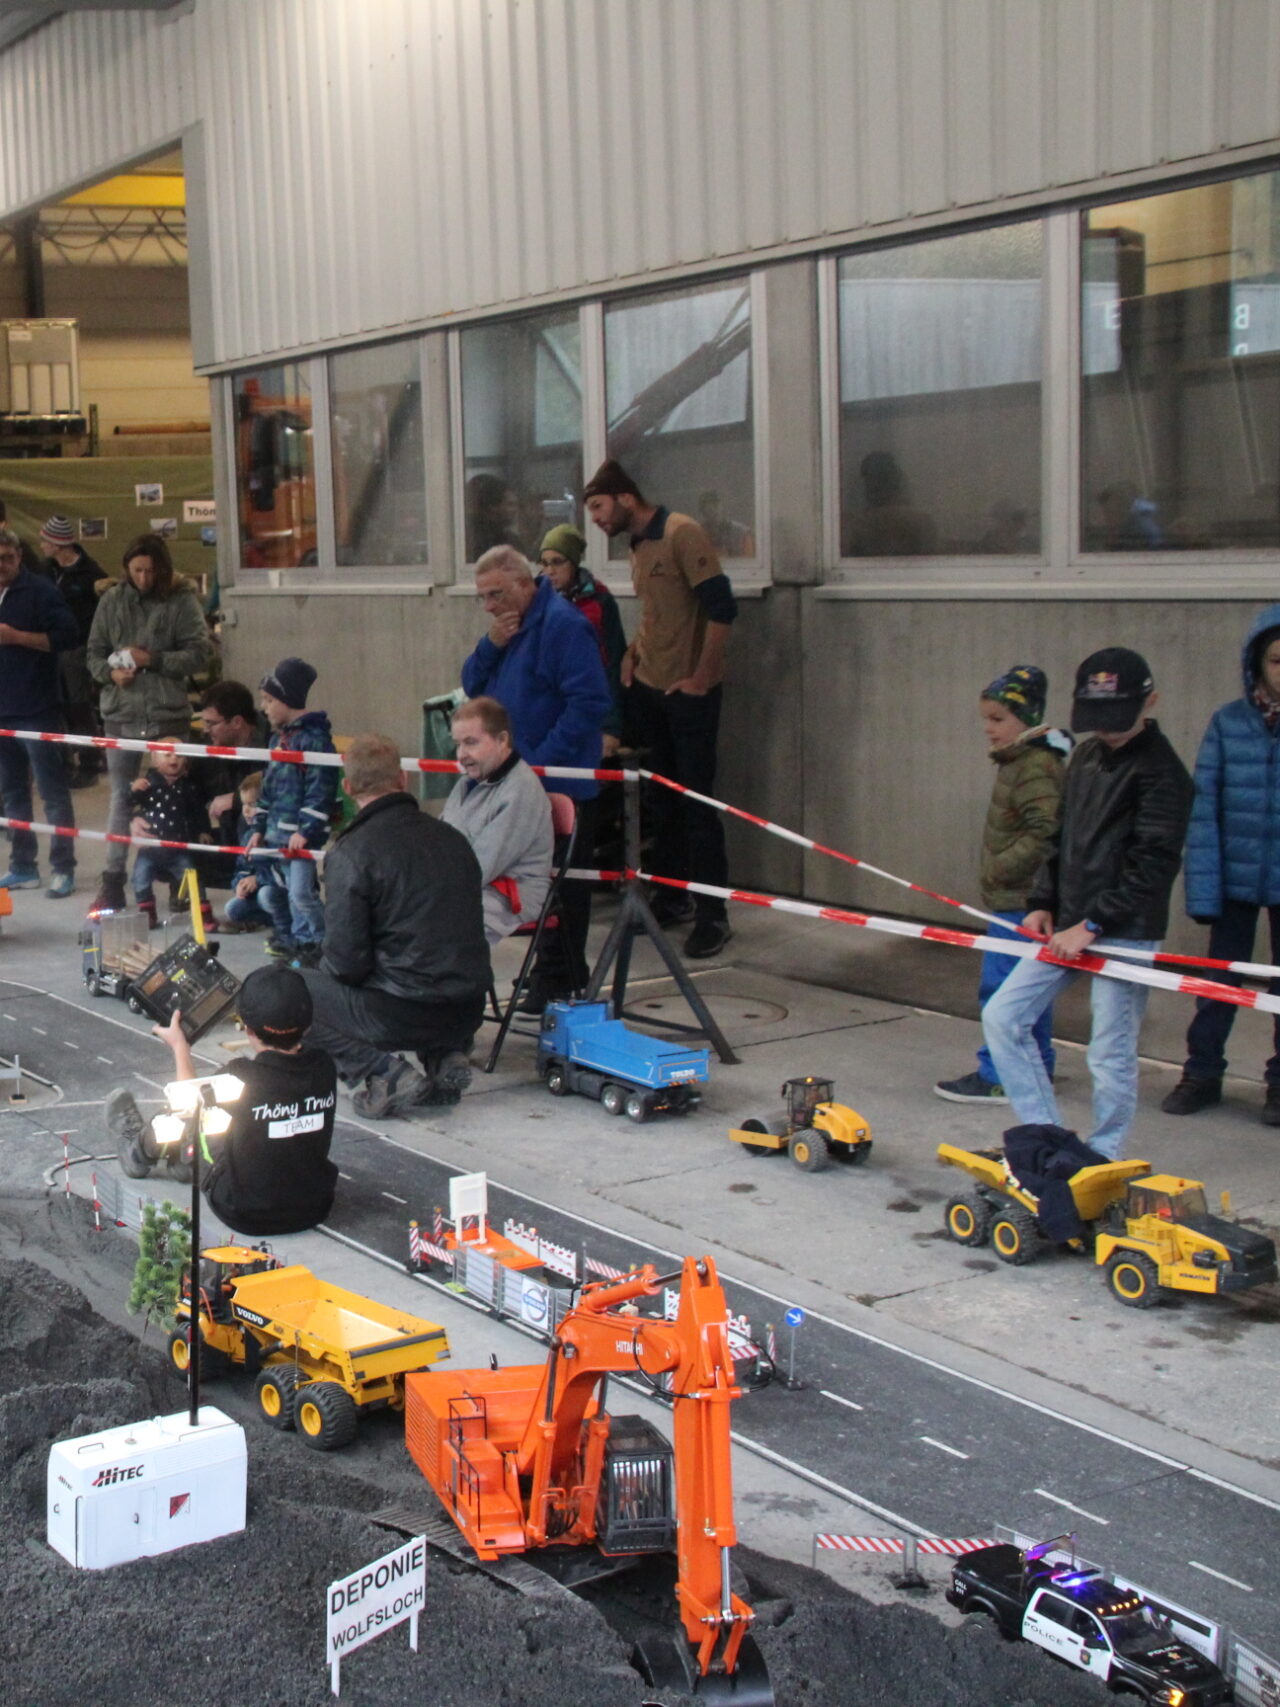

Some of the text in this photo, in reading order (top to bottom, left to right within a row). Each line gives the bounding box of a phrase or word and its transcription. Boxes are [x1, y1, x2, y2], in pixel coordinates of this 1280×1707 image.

[252, 1102, 299, 1121] Thöny
[283, 1117, 314, 1134] TEAM
[236, 1306, 264, 1325] VOLVO
[615, 1340, 643, 1355] HITAHI
[331, 1544, 423, 1616] DEPONIE
[332, 1586, 423, 1651] WOLFSLOCH
[1023, 1621, 1063, 1646] POLICE
